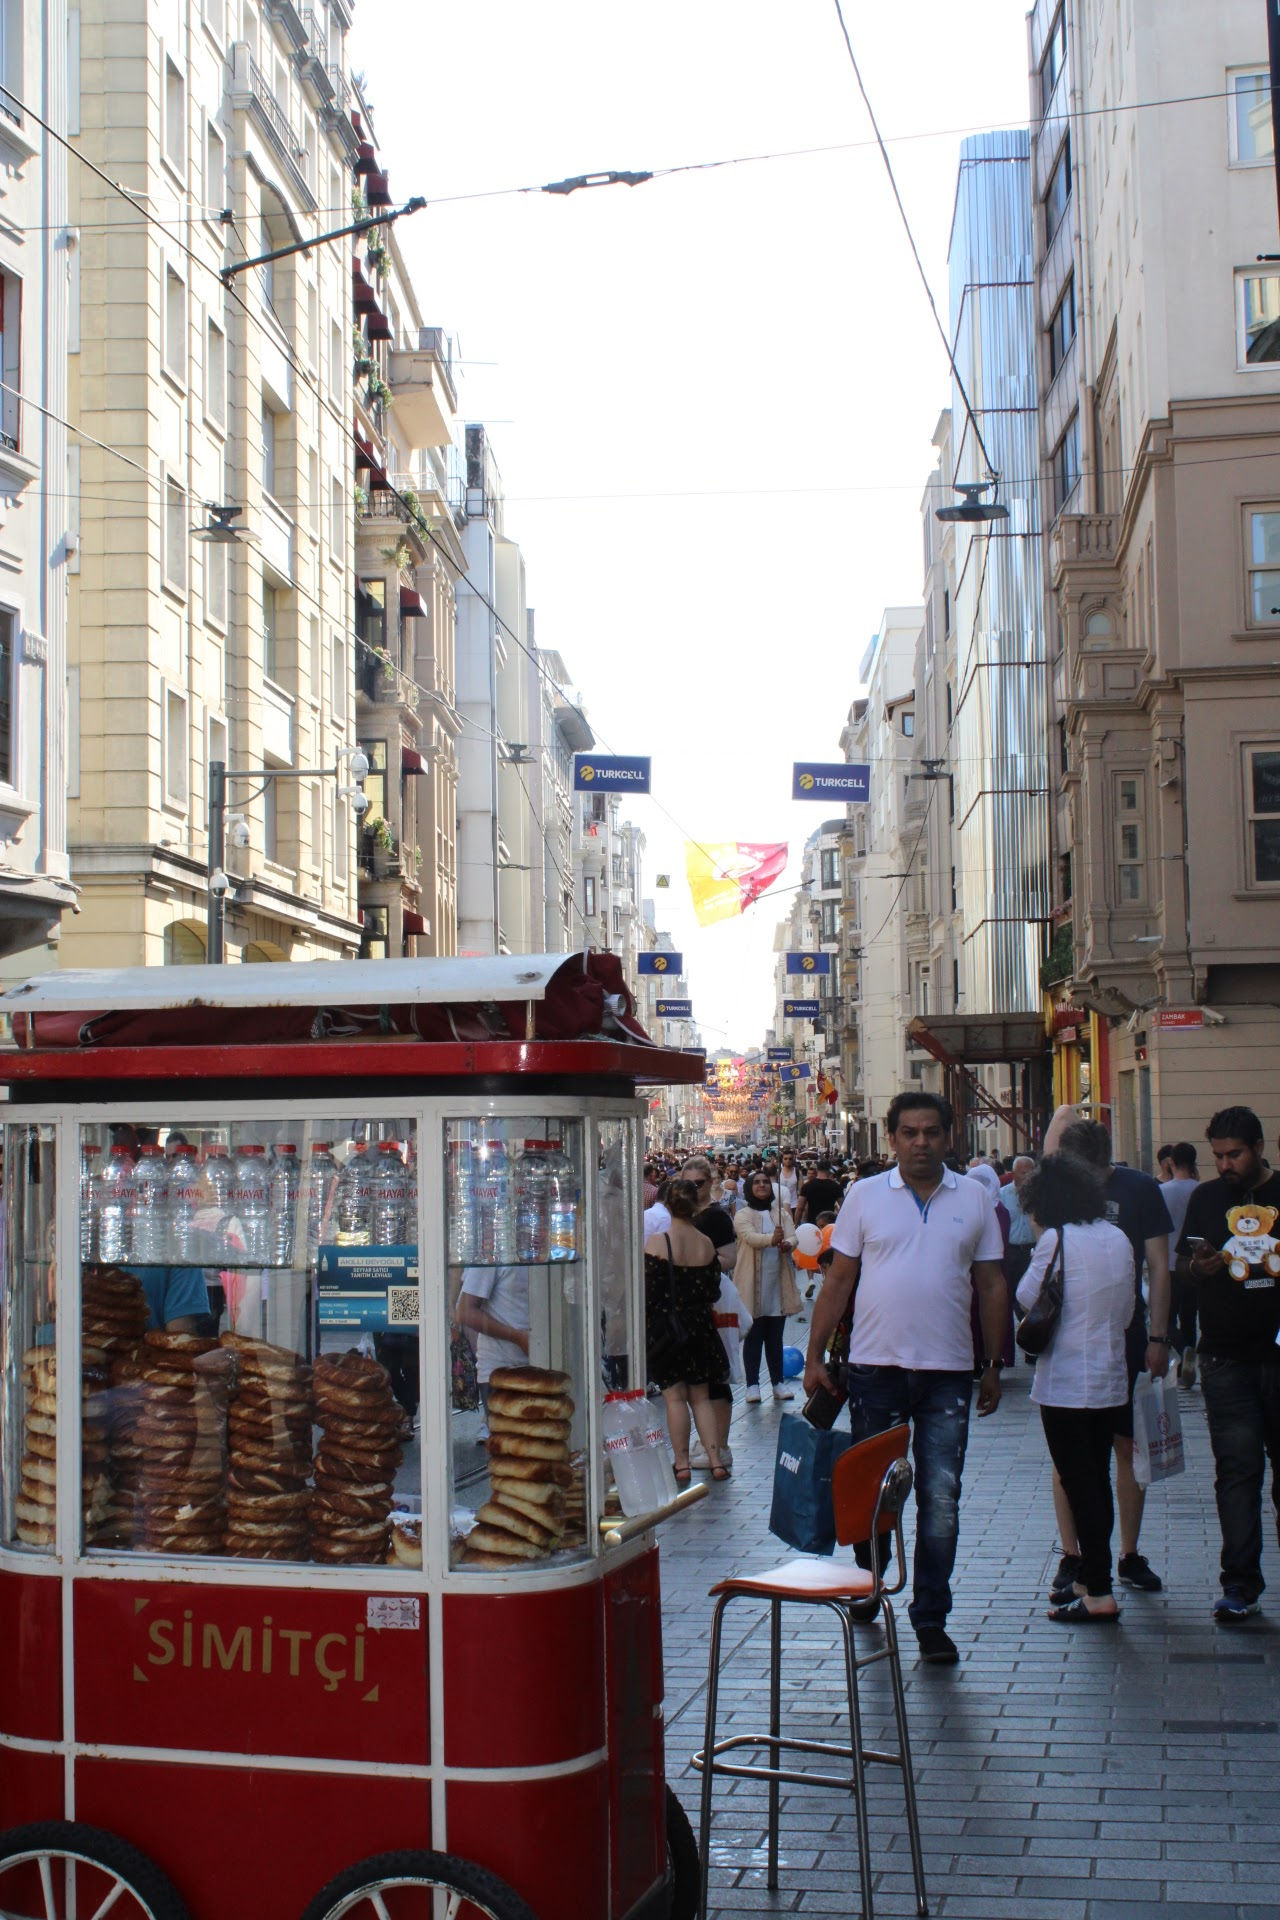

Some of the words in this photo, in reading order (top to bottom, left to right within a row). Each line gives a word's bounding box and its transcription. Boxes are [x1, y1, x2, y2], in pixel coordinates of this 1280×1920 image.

[596, 769, 645, 780] TURKCELL
[815, 777, 865, 788] TURKCELL
[237, 1189, 264, 1200] HAYAT
[148, 1610, 365, 1691] SİMİTÇİ
